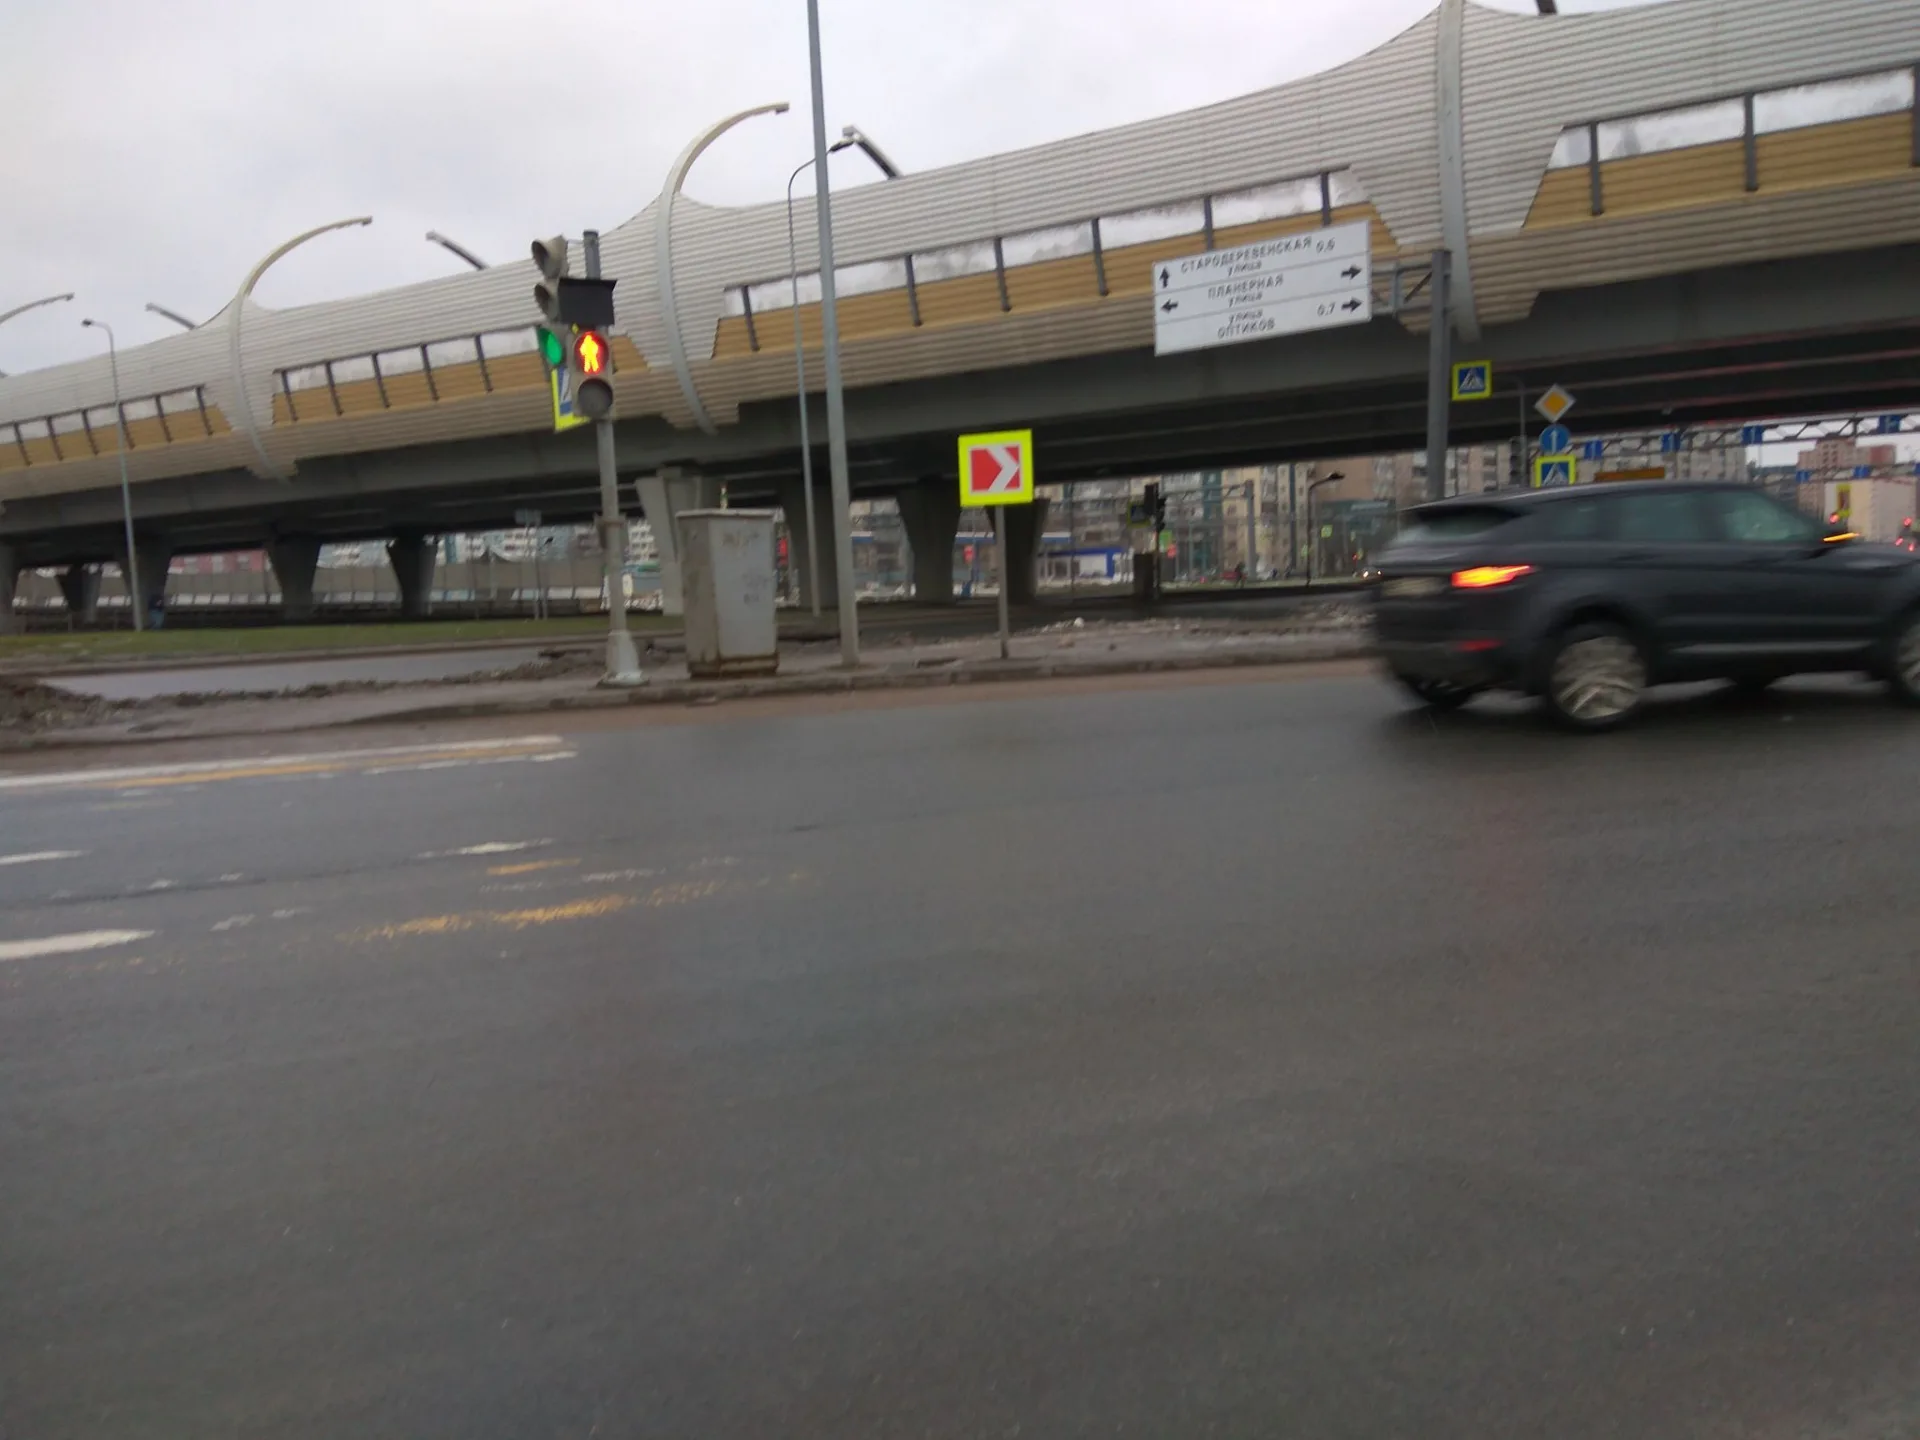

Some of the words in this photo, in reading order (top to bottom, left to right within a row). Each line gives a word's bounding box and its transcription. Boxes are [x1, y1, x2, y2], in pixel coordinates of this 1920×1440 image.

[1181, 236, 1312, 273] СТАРОДЕРЕВЕНСКАЯ
[1207, 274, 1283, 299] ПЛАНЕРНАЯ
[1217, 317, 1276, 338] ОПТИКОВ
